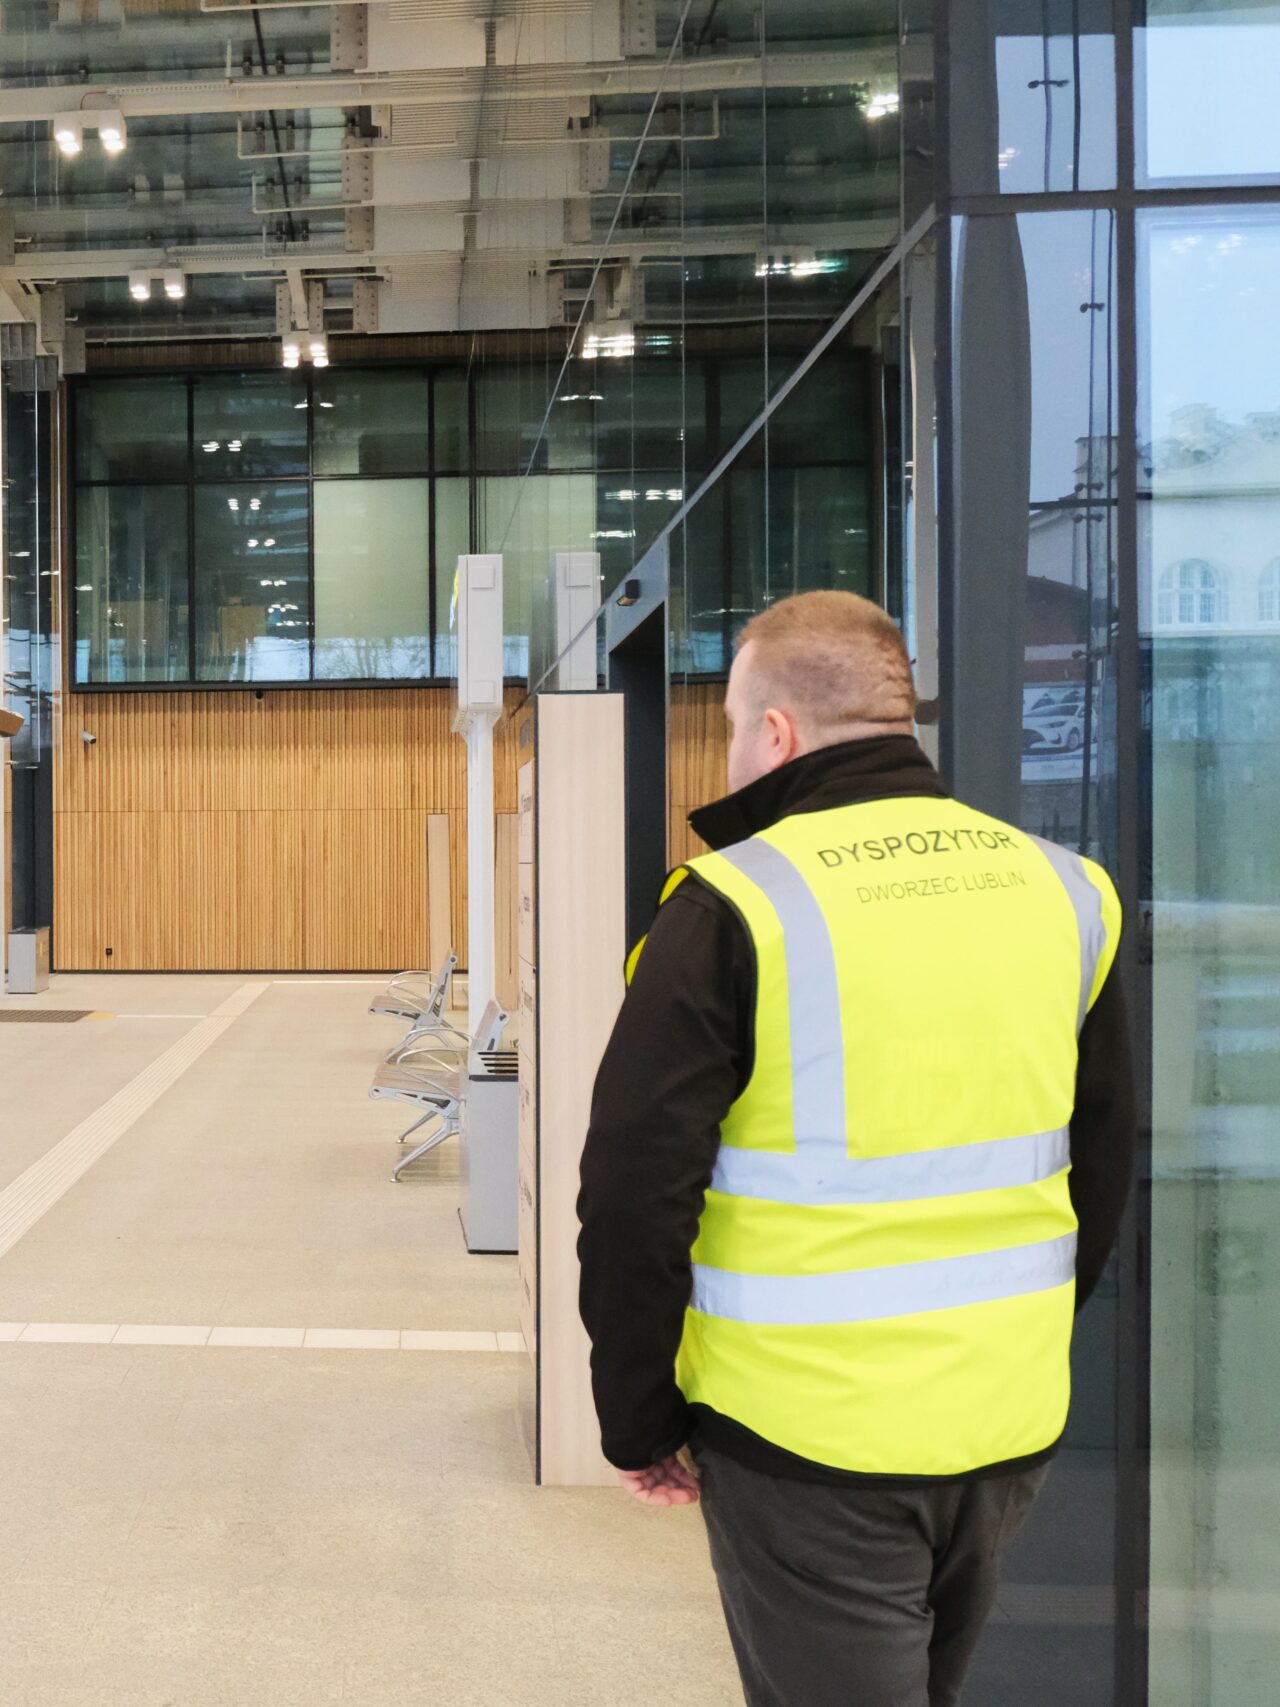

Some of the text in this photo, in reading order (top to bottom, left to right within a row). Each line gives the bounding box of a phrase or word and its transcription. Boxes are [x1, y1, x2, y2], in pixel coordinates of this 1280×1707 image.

[817, 829, 1020, 868] DYSPOZYTOR
[856, 871, 1026, 904] DWORZEC LUBLIN
